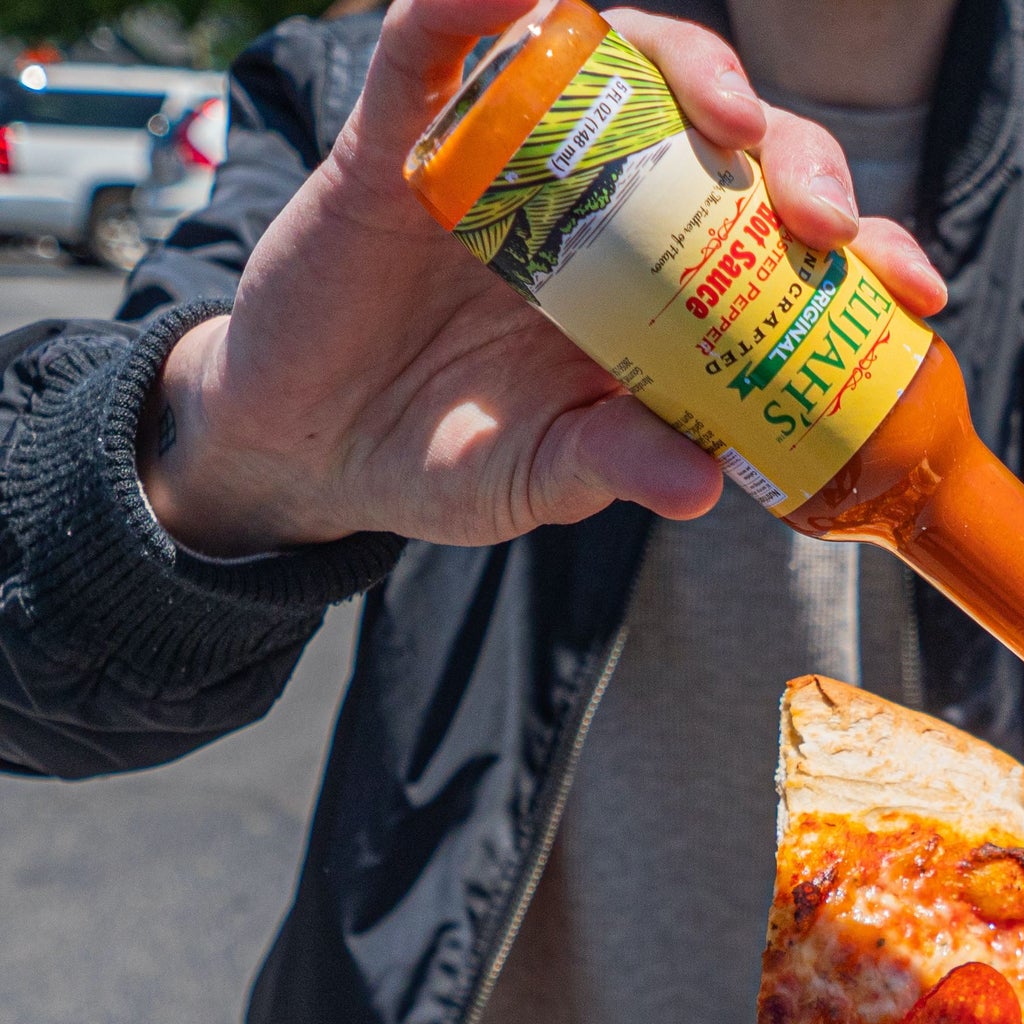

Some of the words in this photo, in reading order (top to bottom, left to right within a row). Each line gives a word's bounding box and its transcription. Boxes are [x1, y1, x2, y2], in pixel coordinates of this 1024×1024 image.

[604, 88, 622, 101] FL
[614, 81, 628, 92] 5
[592, 101, 612, 122] OZ
[571, 117, 600, 147] (148
[550, 144, 577, 173] mL)
[703, 190, 720, 207] The
[682, 204, 709, 234] Father
[741, 200, 782, 249] Hot
[671, 232, 685, 247] of
[650, 244, 678, 274] Flavor
[754, 230, 794, 282] ASTED
[685, 239, 756, 321] Sauce
[693, 280, 761, 356] PEPPER
[703, 250, 816, 375] NDCRAFTED
[767, 281, 838, 359] ORIGINAL
